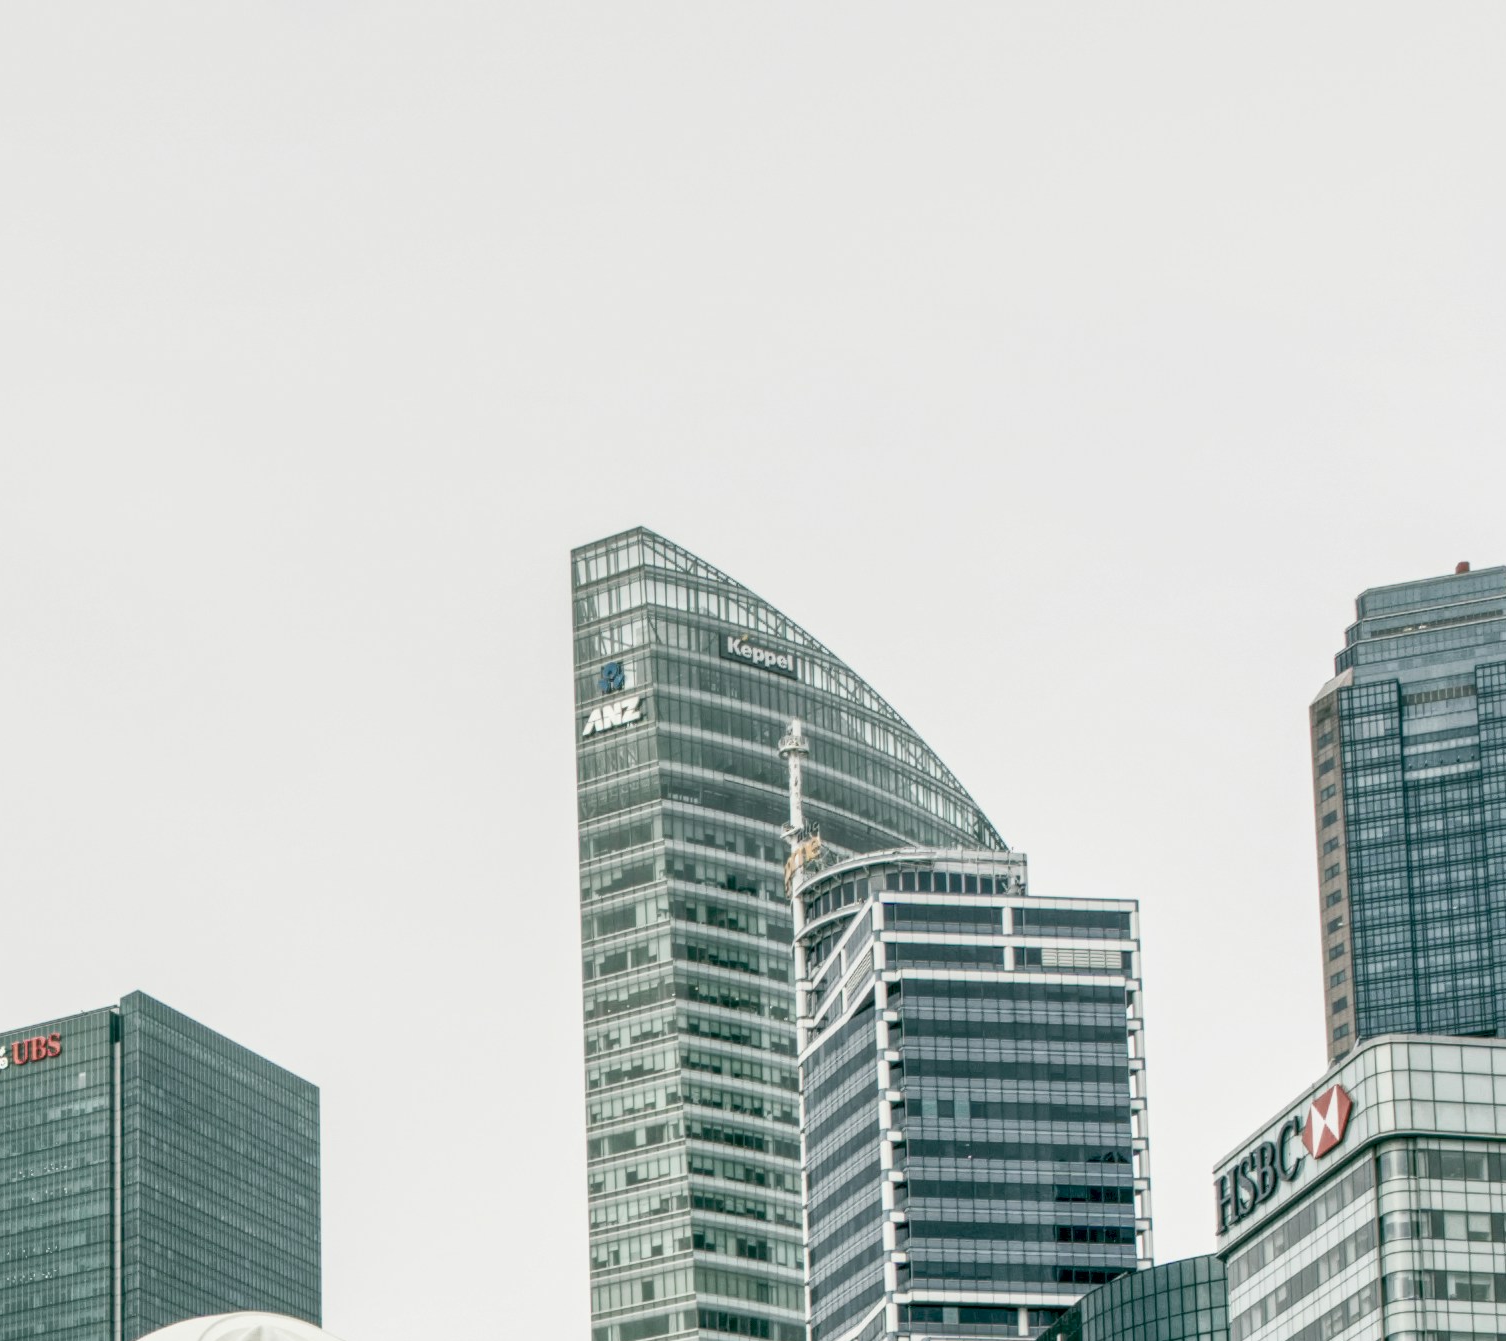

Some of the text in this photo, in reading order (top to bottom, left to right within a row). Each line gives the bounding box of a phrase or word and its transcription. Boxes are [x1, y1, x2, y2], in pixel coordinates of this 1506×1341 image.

[727, 636, 794, 672] Keppel
[582, 697, 643, 736] ANZ
[11, 1032, 62, 1065] UBS
[1213, 1115, 1306, 1236] HSBC
